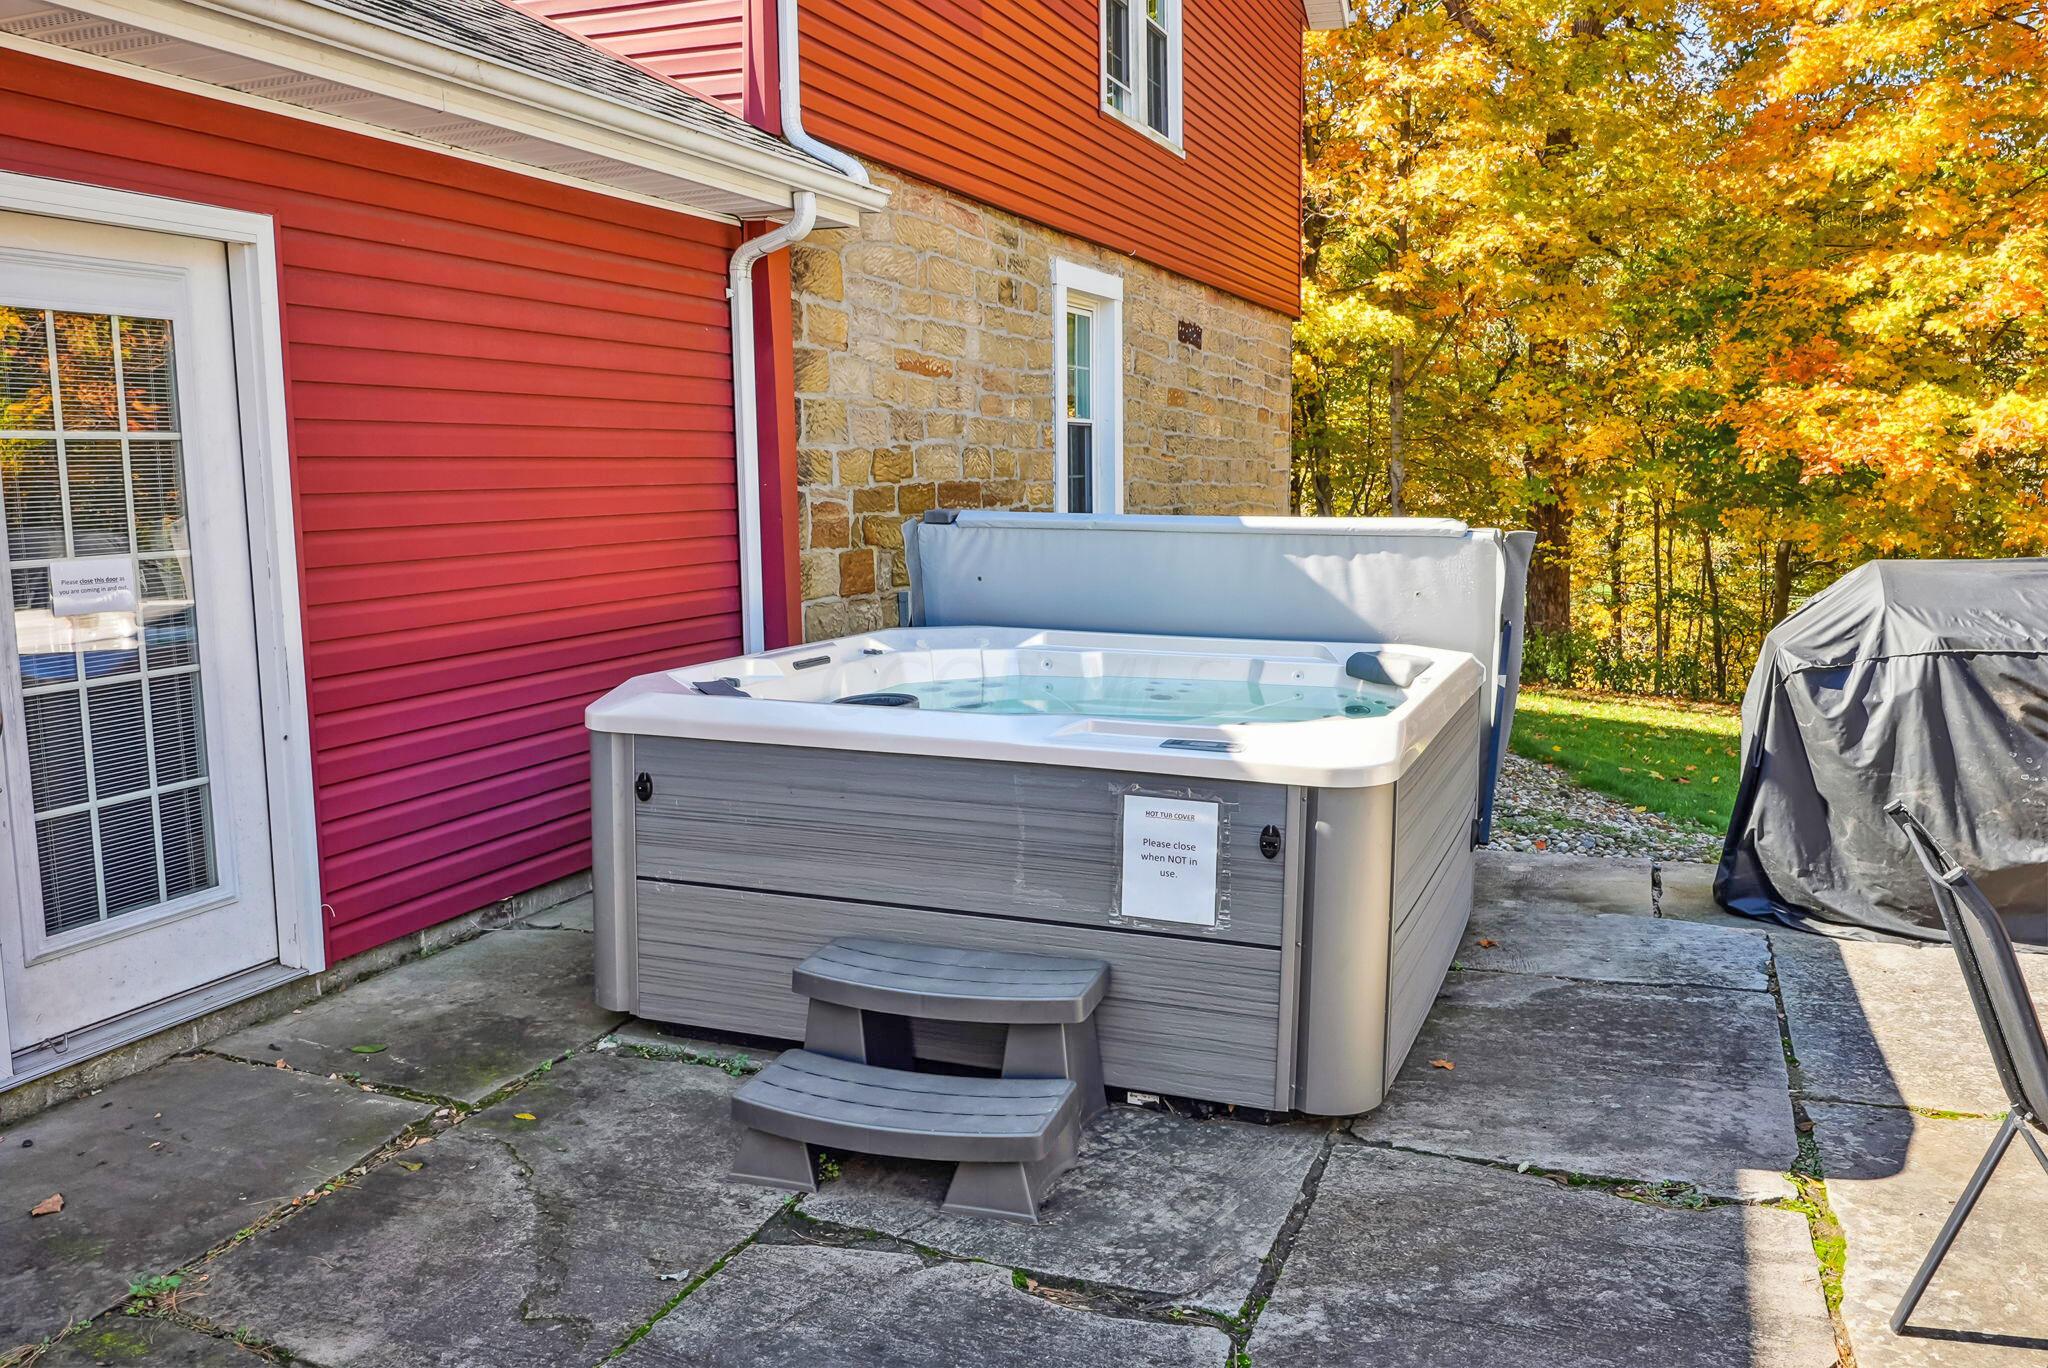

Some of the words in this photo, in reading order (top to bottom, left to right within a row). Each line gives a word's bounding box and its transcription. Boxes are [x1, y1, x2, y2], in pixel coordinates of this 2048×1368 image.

[1174, 813, 1195, 821] COVER
[1143, 838, 1171, 849] Please
[1173, 842, 1196, 851] close
[1141, 853, 1165, 862] when
[1167, 855, 1187, 865] NOT
[1189, 858, 1197, 866] in
[1160, 870, 1178, 878] use.
